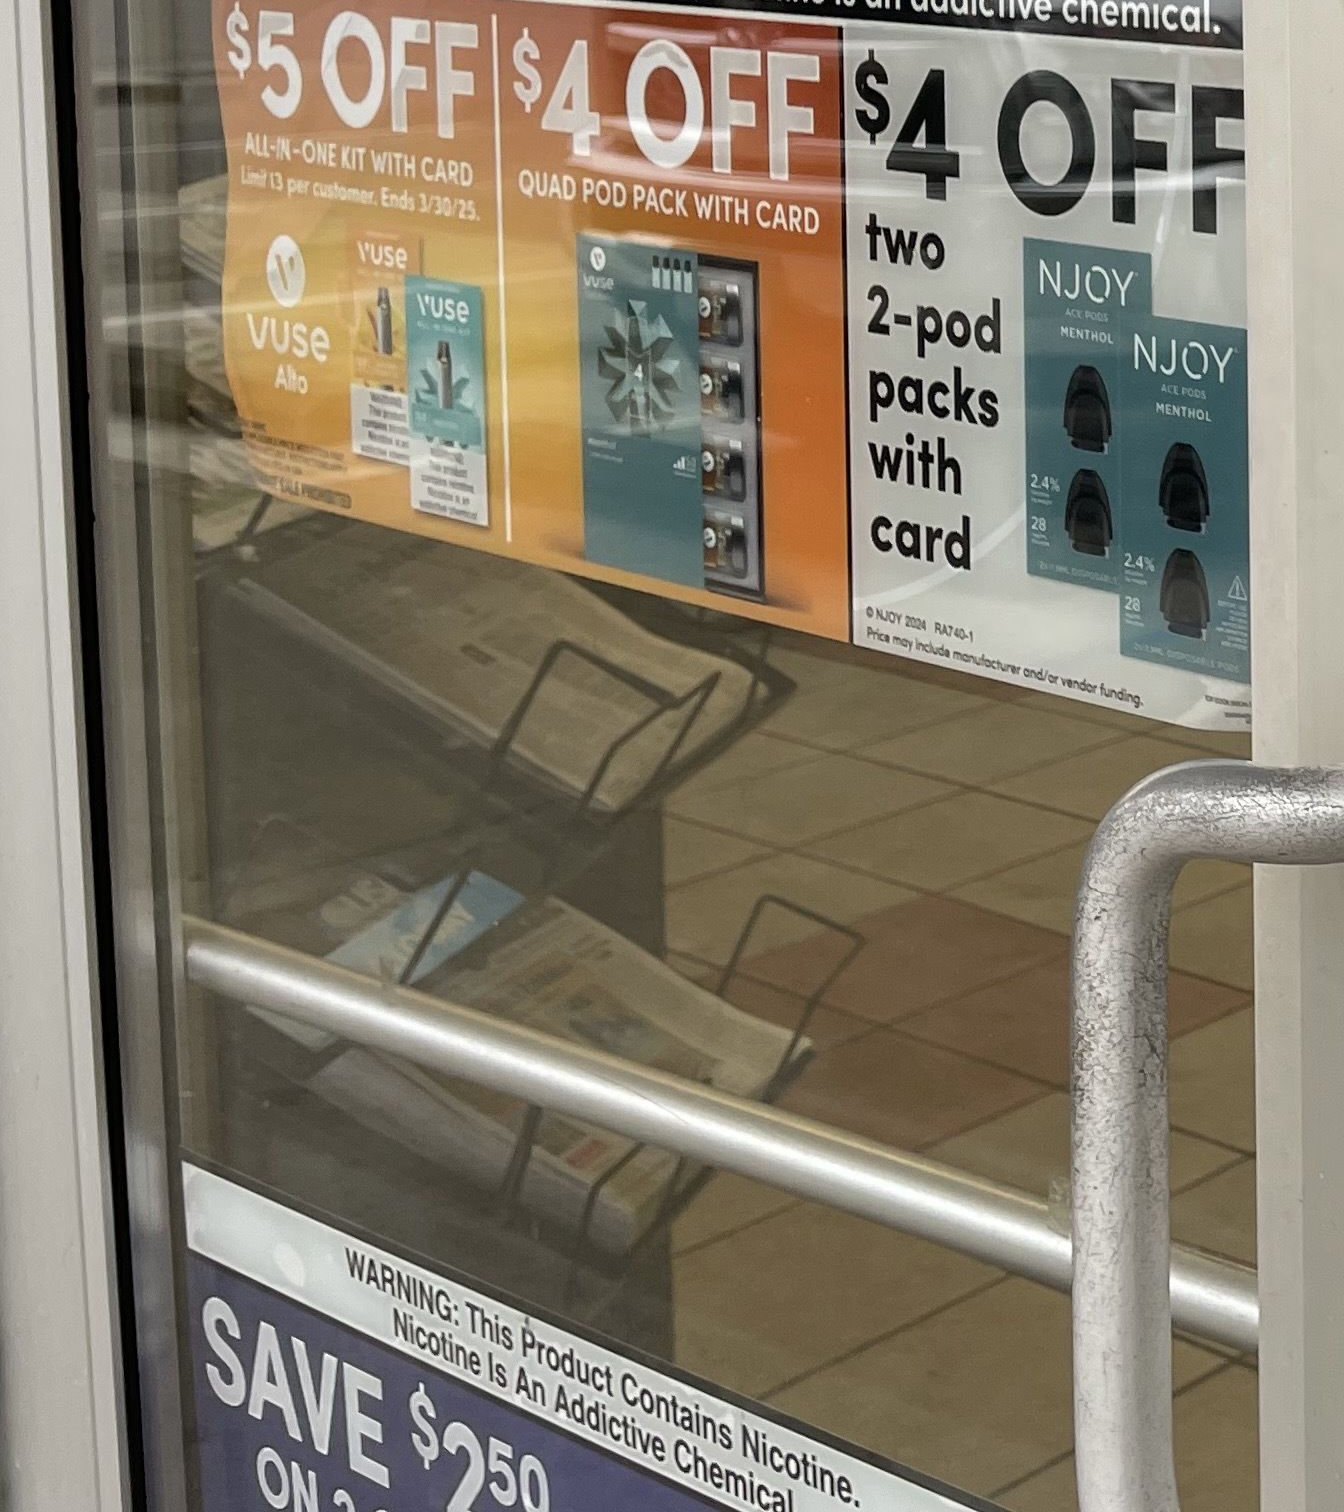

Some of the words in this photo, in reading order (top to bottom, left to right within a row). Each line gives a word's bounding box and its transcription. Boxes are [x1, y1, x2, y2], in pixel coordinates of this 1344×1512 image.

[225, 0, 304, 120] $5
[320, 9, 480, 140] OFF
[512, 27, 601, 158] $4
[625, 38, 821, 182] OFF
[244, 131, 337, 168] ALL-IN-ONE
[341, 146, 366, 172] KIT
[369, 150, 416, 179] WITH
[420, 156, 473, 187] CARD
[855, 49, 960, 201] $4
[997, 70, 1245, 234] OFF
[287, 176, 310, 199] per
[380, 187, 415, 212] Ends
[517, 169, 577, 201] QUAD
[582, 176, 627, 209] POD
[632, 182, 689, 218] PACK
[693, 188, 751, 228] WITH
[755, 199, 821, 235] CARD
[866, 213, 945, 270] two
[1039, 259, 1134, 306] NJOY
[867, 285, 1001, 357] 2-pod
[1060, 326, 1114, 345] MENTHOL
[1134, 334, 1234, 384] NJOY
[868, 366, 999, 428] packs
[1155, 402, 1212, 422] MENTHOL
[868, 432, 962, 495] with
[1030, 474, 1060, 492] 2.4%
[870, 515, 971, 570] card
[1031, 516, 1046, 531] 28
[1124, 553, 1155, 572] 2.4%
[875, 608, 902, 627] NJOY
[1125, 596, 1141, 611] 28
[867, 627, 890, 644] Price
[893, 634, 913, 650] may
[915, 637, 950, 658] include
[953, 648, 1021, 677] manufacturer
[1023, 666, 1059, 685] and/or
[1060, 673, 1098, 695] vendor
[1100, 682, 1144, 709] funding.
[202, 1296, 390, 1489] SAVE
[345, 1247, 460, 1327] WARNING:
[465, 1301, 513, 1350] This
[521, 1327, 614, 1398] Product
[621, 1373, 733, 1451] Contains
[741, 1423, 861, 1508] Nicotine.
[393, 1308, 481, 1376] Nicotine
[488, 1350, 508, 1388] Is
[515, 1368, 546, 1408] An
[554, 1383, 665, 1463] Addictive
[673, 1436, 795, 1512] Chemical
[256, 1446, 319, 1512] ON
